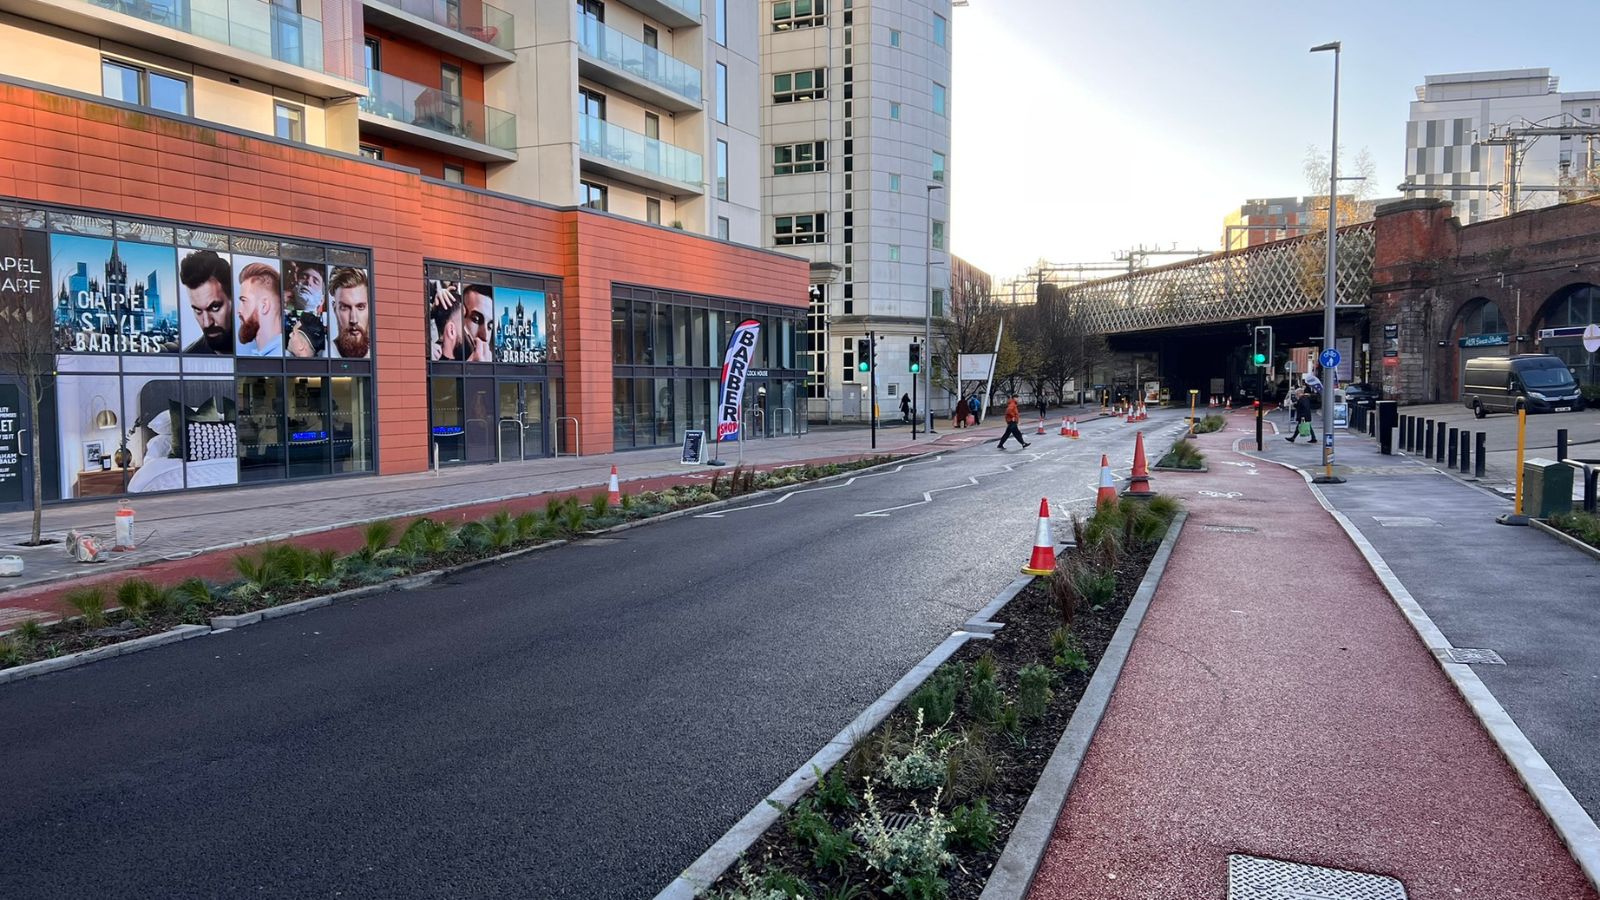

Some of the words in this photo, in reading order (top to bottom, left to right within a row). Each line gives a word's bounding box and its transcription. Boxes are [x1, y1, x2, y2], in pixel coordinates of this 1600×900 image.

[77, 290, 154, 313] CHAPEL
[81, 312, 154, 335] STYLE
[504, 324, 535, 337] CHAPEL
[76, 332, 164, 353] BARBERS
[506, 337, 536, 352] STYLE
[503, 350, 540, 363] BARBERS
[723, 330, 755, 423] BARBER
[720, 422, 738, 434] SHOP
